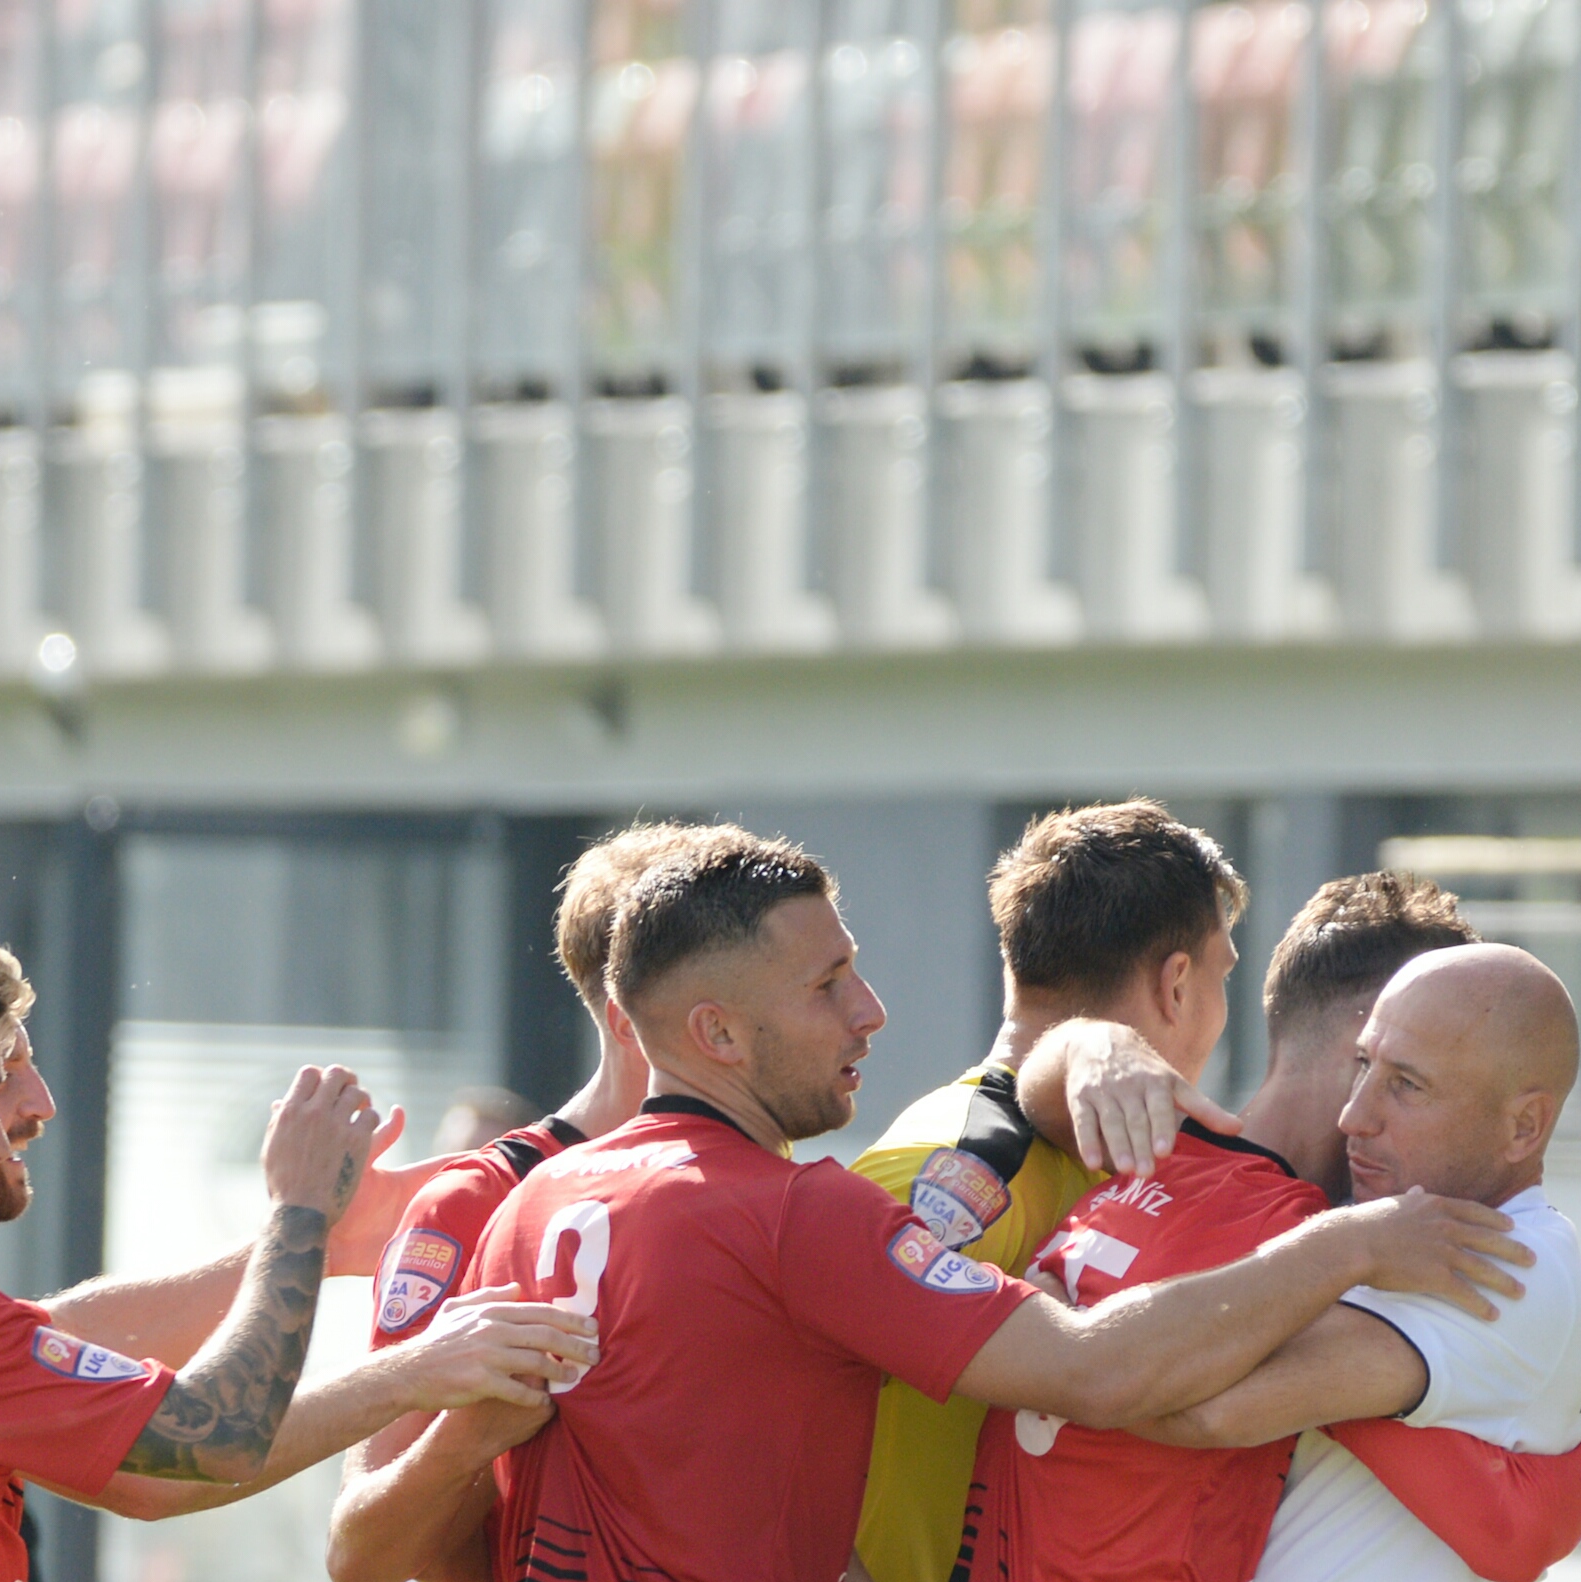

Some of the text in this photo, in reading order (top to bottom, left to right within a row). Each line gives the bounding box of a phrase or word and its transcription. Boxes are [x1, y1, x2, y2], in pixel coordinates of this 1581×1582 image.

[918, 1189, 956, 1225] LIGA
[957, 1220, 975, 1238] 2
[418, 1285, 432, 1301] 2
